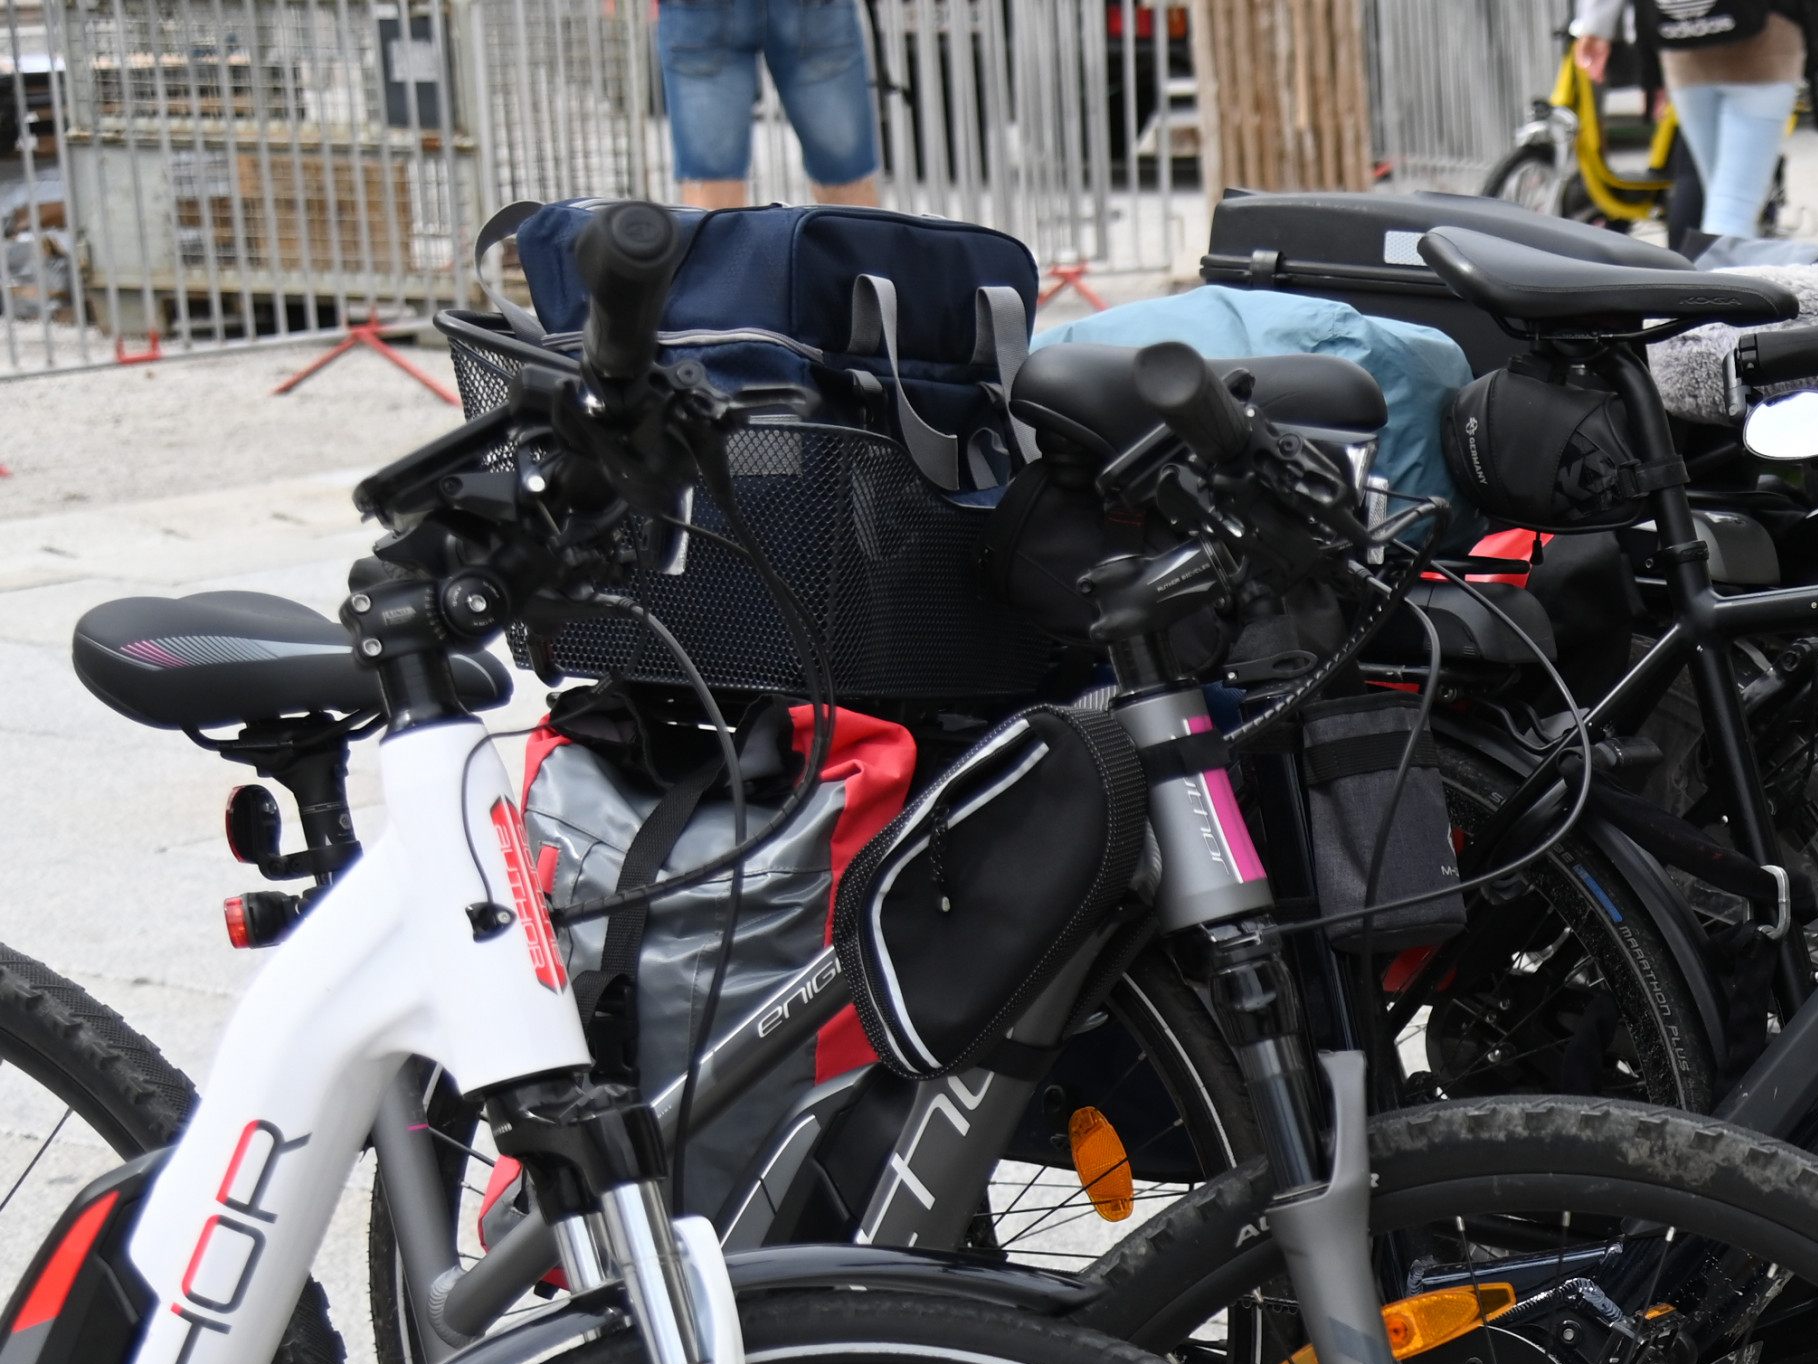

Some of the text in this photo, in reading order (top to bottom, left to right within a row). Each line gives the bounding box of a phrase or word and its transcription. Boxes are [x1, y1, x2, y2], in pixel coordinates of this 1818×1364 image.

[1468, 436, 1489, 486] GERMANY
[1618, 925, 1691, 1073] MARATHON PLUS
